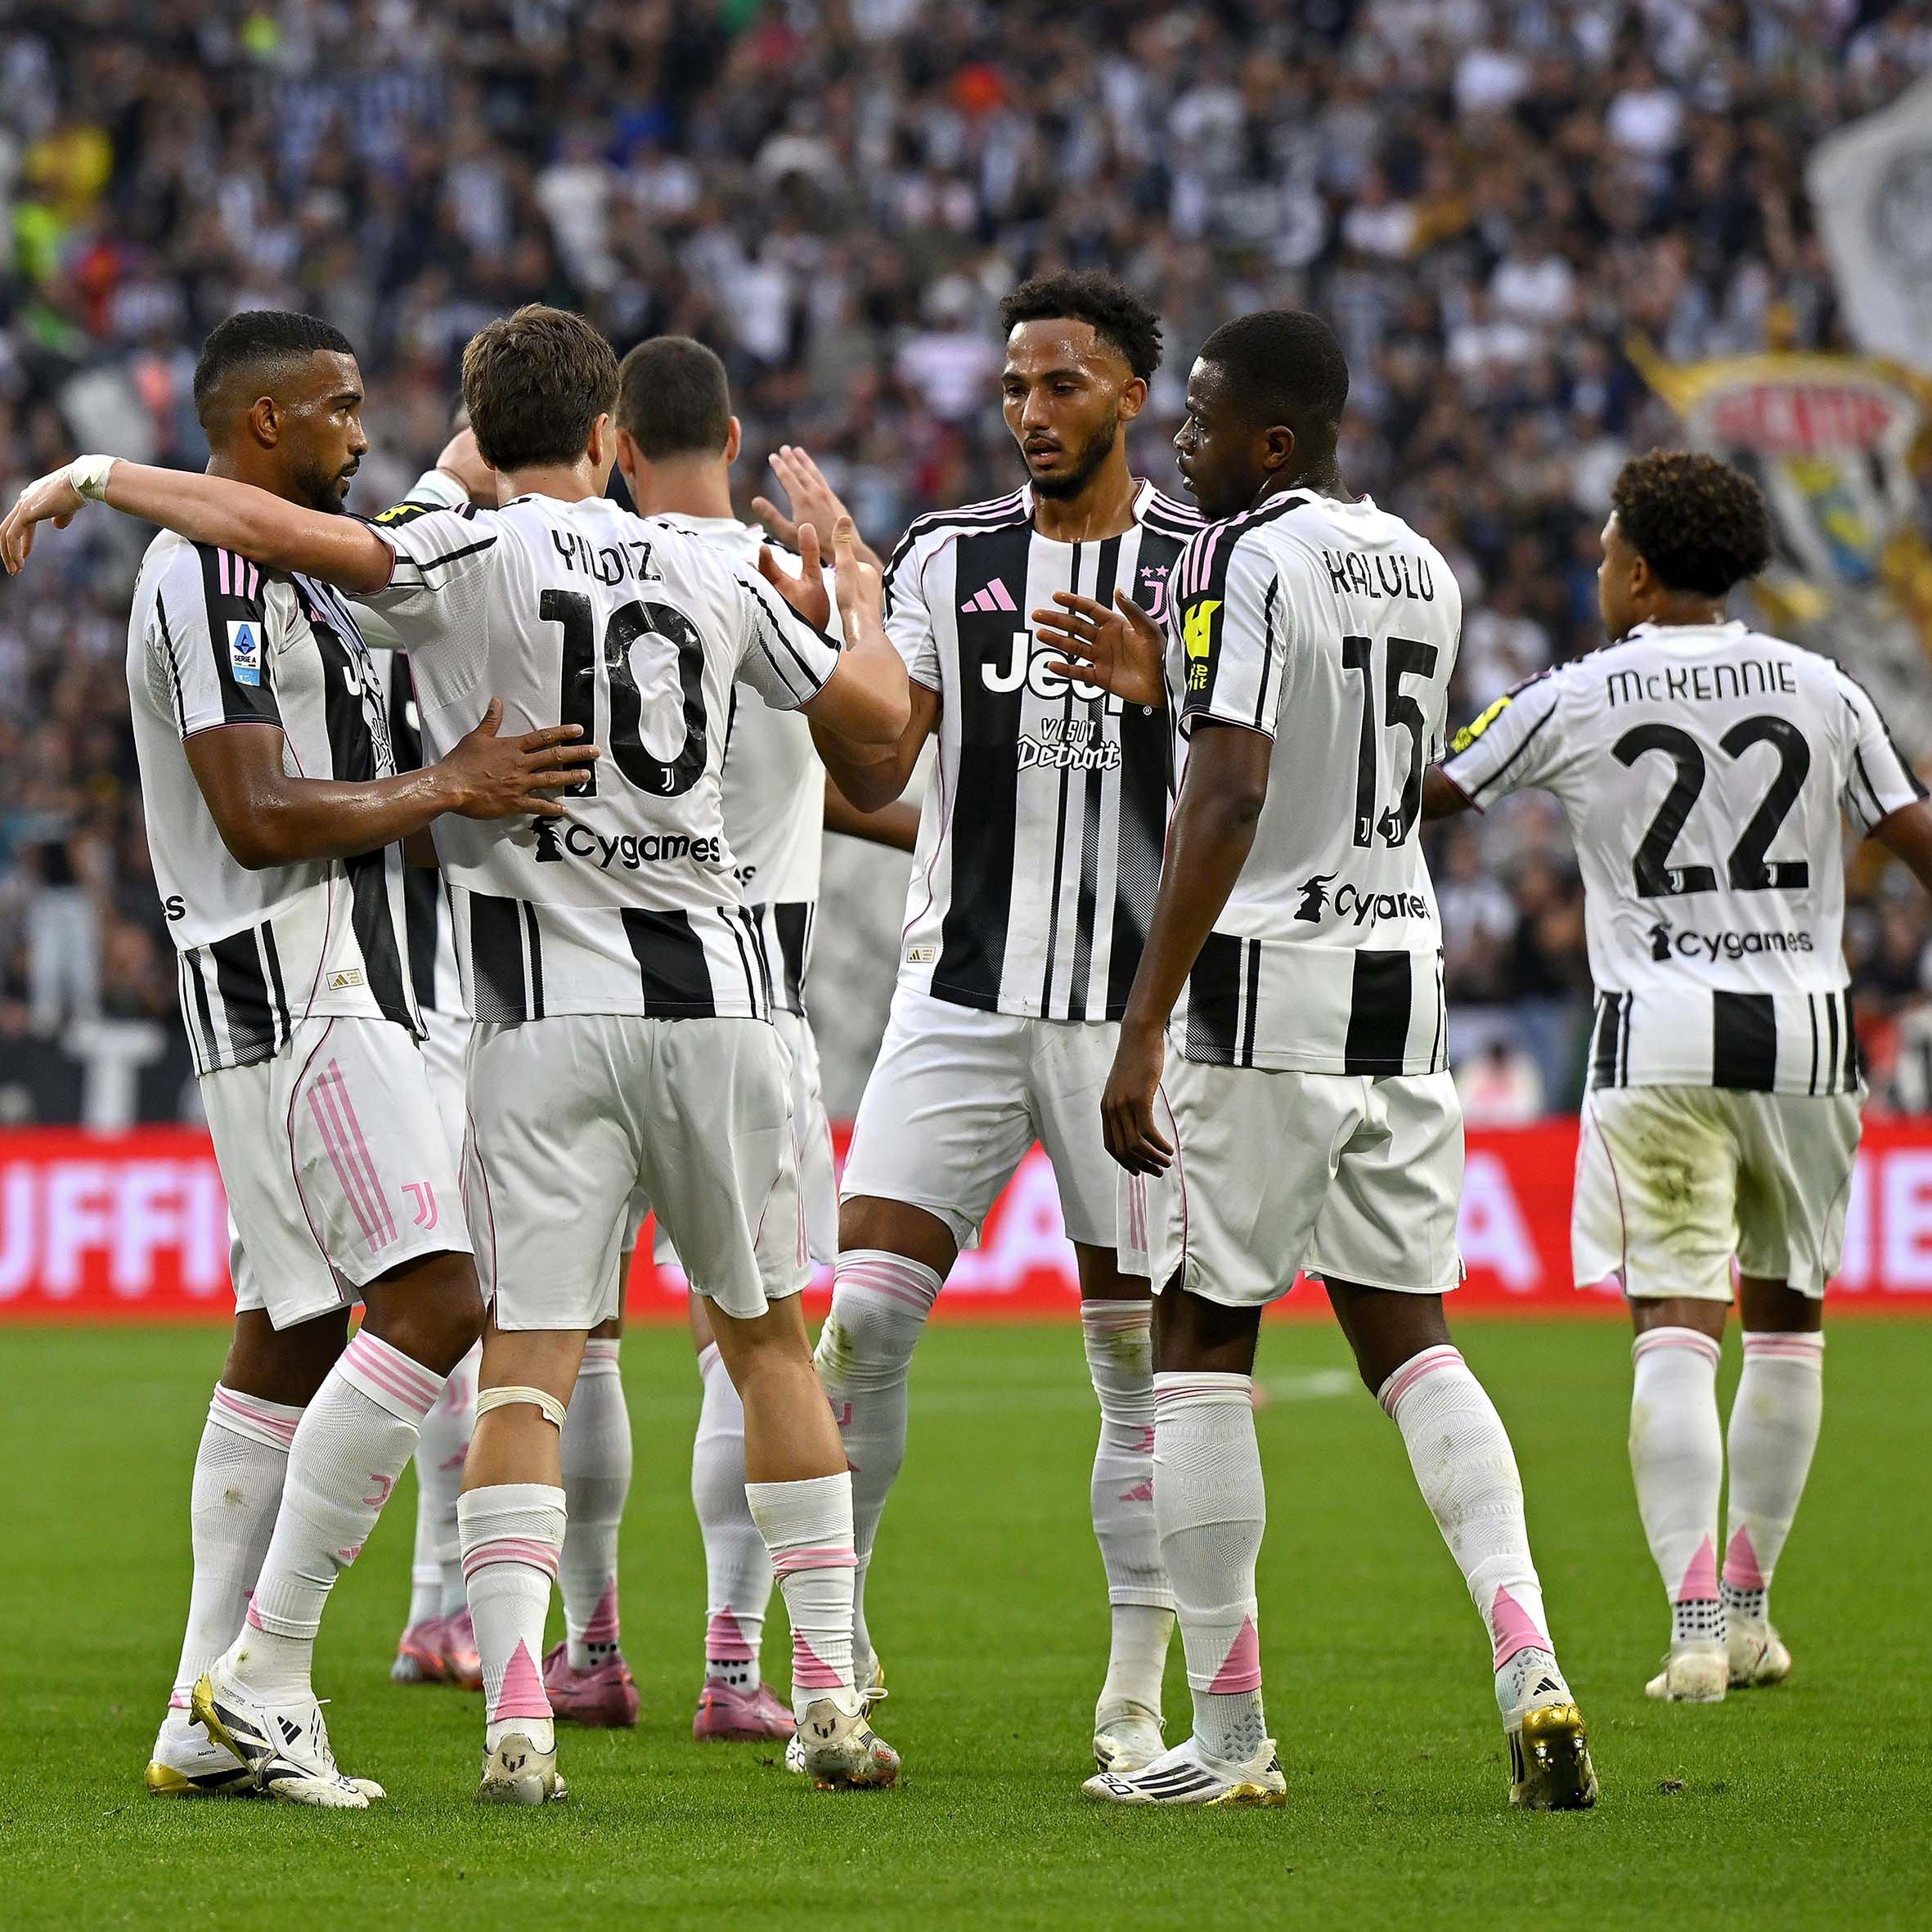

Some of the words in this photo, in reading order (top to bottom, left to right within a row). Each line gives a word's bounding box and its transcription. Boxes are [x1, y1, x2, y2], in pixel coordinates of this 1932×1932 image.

[551, 529, 662, 586] YILDIZ
[1322, 550, 1434, 602] KALULU
[234, 654, 251, 663] SERIE
[981, 631, 1125, 713] Jee
[538, 588, 708, 798] 10
[1016, 735, 1121, 771] Detroit
[1041, 718, 1097, 742] VISIT
[1341, 636, 1439, 849] 15
[1611, 715, 1810, 898] 22
[564, 824, 721, 869] Cygames
[1675, 929, 1813, 963] Cygames
